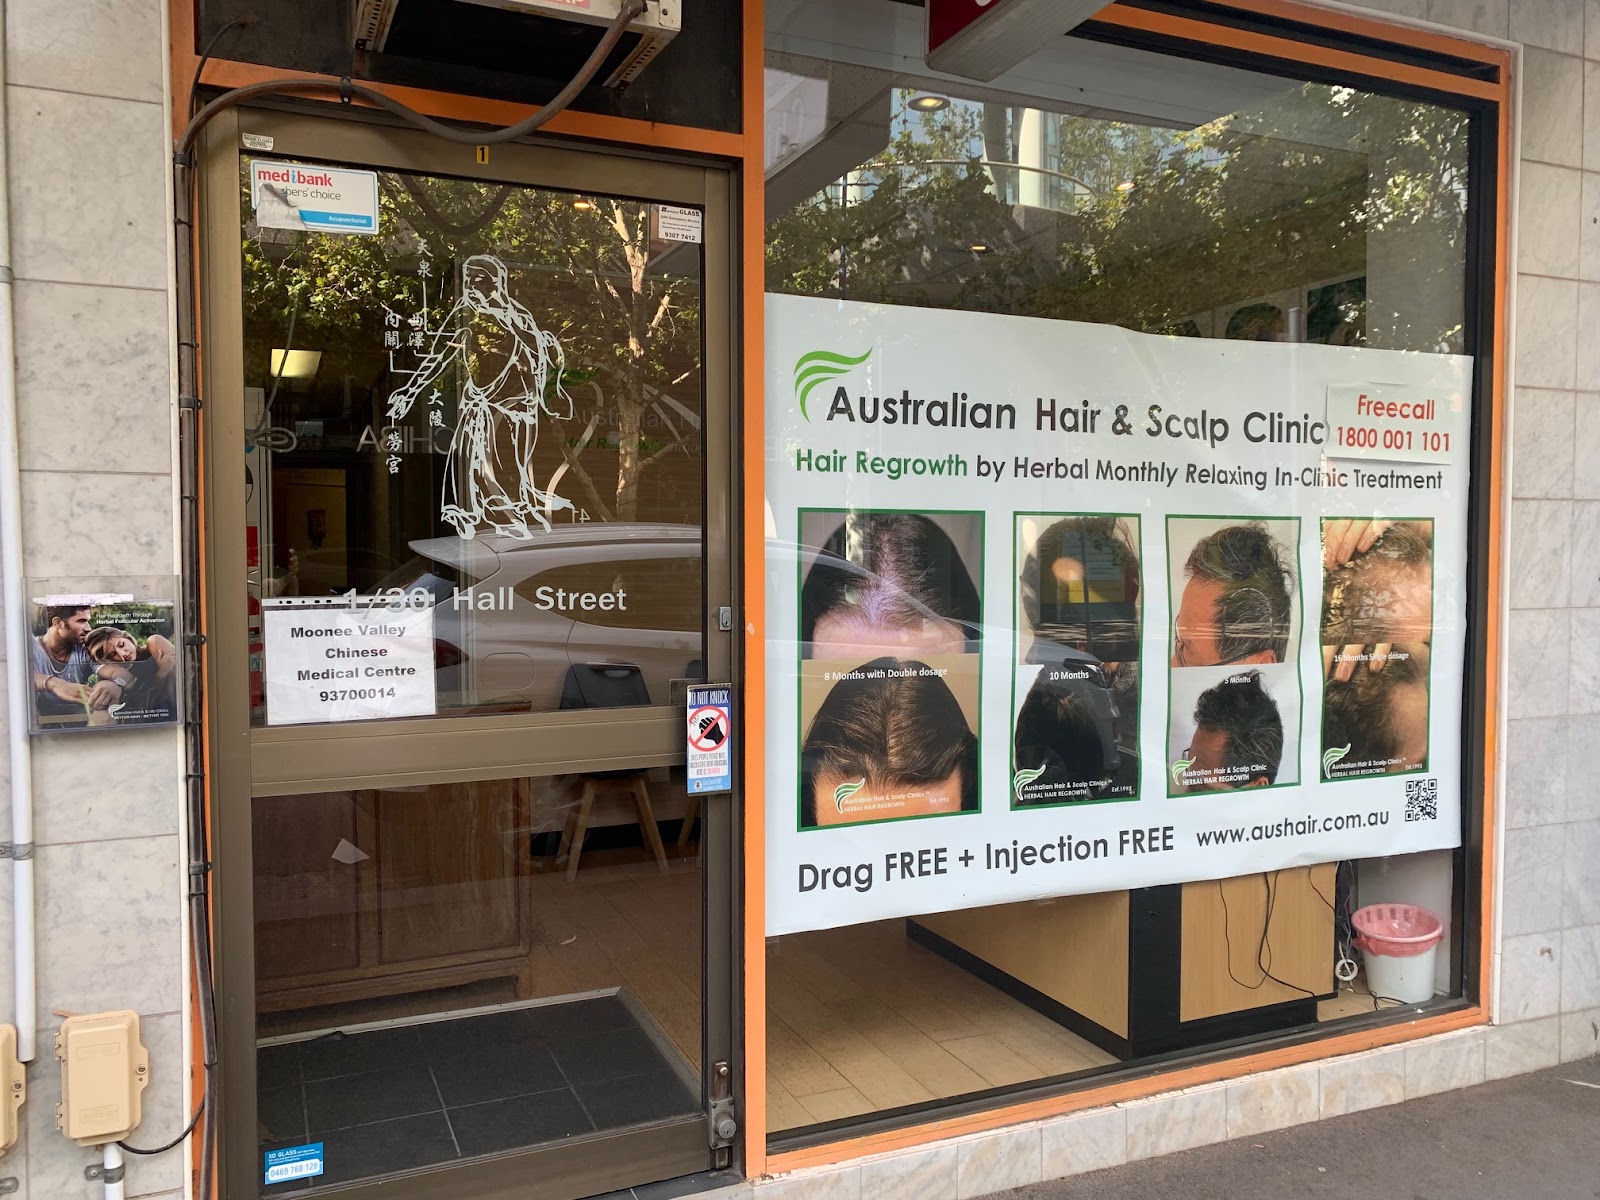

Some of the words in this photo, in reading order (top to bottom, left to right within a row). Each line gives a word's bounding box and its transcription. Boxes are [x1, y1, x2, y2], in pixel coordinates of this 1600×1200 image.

[480, 147, 485, 162] 1
[258, 169, 333, 187] medibank
[285, 186, 309, 198] bers'
[311, 188, 341, 201] choice
[680, 209, 700, 217] GLASS
[681, 233, 696, 241] 7412
[427, 388, 446, 428] 大陵
[1358, 394, 1435, 421] Freecall
[826, 385, 1016, 430] Australian
[1035, 397, 1101, 434] Hair
[1111, 404, 1133, 436] &
[1145, 404, 1229, 448] Scalp
[1243, 411, 1324, 445] Clinic
[1337, 426, 1378, 449] 1800
[1383, 429, 1412, 450] 001
[1422, 431, 1450, 452] 101
[796, 448, 847, 473] Hair
[856, 450, 968, 480] Regrowth
[977, 455, 1006, 482] by
[1013, 456, 1089, 480] Herbal
[1096, 460, 1178, 487] Monthly
[1186, 463, 1267, 491] Relaxing
[1275, 467, 1348, 488] In-Clinic
[1354, 468, 1443, 490] Treatment
[342, 586, 431, 619] 1/30
[453, 586, 514, 611] Hall
[534, 586, 627, 611] Street
[290, 625, 353, 639] Moonee
[357, 624, 406, 638] Valley
[325, 646, 388, 659] Chinese
[1334, 654, 1342, 662] 16
[1343, 652, 1368, 662] Months
[1369, 652, 1387, 662] Single
[1388, 651, 1410, 661] dosage
[297, 667, 359, 681] Medical
[364, 665, 416, 678] Centre
[824, 672, 830, 681] 8
[832, 670, 865, 681] Months
[867, 669, 886, 679] with
[887, 667, 918, 678] Double
[919, 667, 948, 678] dosage
[1049, 671, 1059, 681] 10
[1060, 670, 1090, 680] Months
[1230, 676, 1251, 684] Months
[319, 687, 396, 702] 93700014
[697, 690, 709, 705] NOT
[710, 689, 729, 705] KNOCK
[1183, 769, 1212, 778] Australian
[1233, 765, 1249, 774] Scalp
[1024, 782, 1053, 791] Australian
[1072, 780, 1088, 788] Scalp
[1089, 779, 1107, 787] Clinics
[1182, 778, 1203, 786] HERBAL
[1218, 774, 1250, 782] REGROWTH
[1058, 789, 1087, 797] REGROWTH
[1196, 810, 1390, 847] www.aushair.com.au
[799, 862, 873, 893] Drag
[885, 847, 948, 882] FREE
[958, 849, 975, 868] +
[986, 834, 1108, 875] Injection
[1119, 826, 1174, 856] FREE
[277, 1149, 297, 1158] GLASS
[270, 1167, 288, 1178] 0469
[290, 1164, 304, 1174] 768
[305, 1162, 318, 1171] 128
